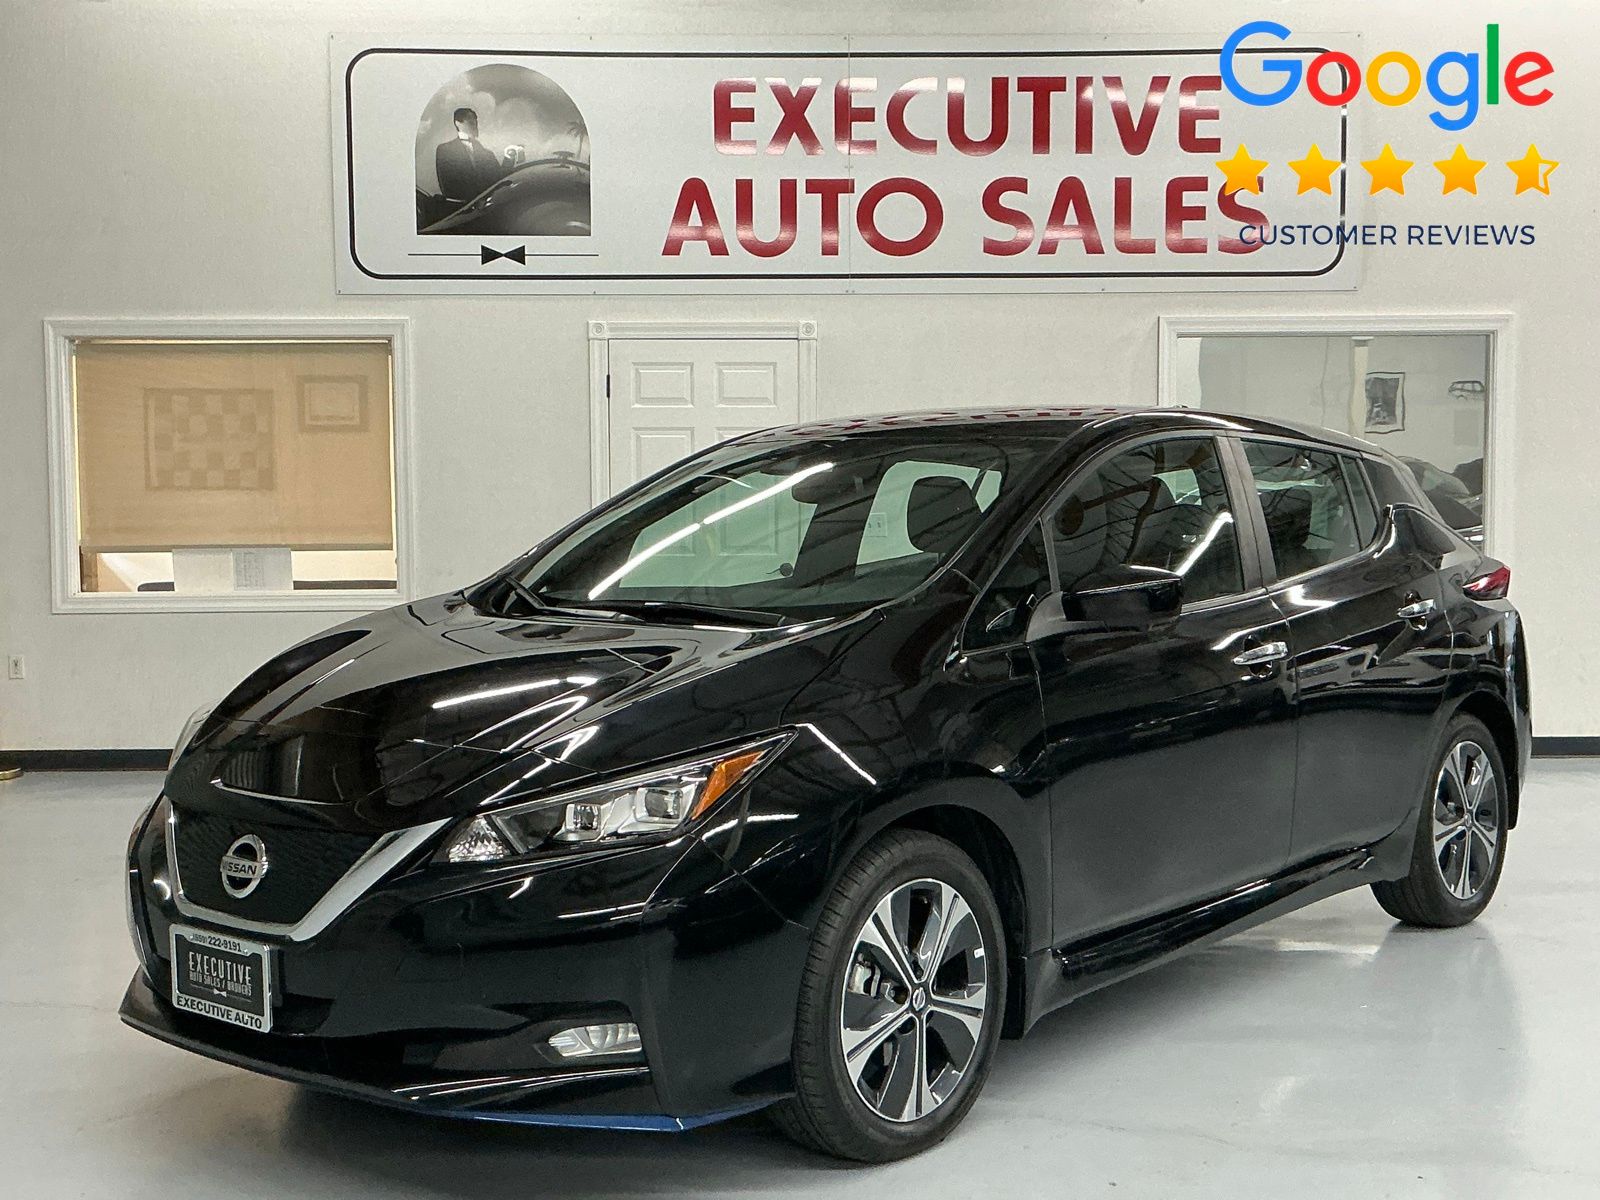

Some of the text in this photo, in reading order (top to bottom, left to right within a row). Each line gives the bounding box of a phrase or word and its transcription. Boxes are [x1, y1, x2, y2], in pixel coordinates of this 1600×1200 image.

[713, 75, 1222, 156] EXECUTIVE
[661, 176, 1270, 258] AUTO SALES
[188, 951, 252, 986] EXECUTIVE
[177, 995, 262, 1029] EXECUTIVE AUTO
